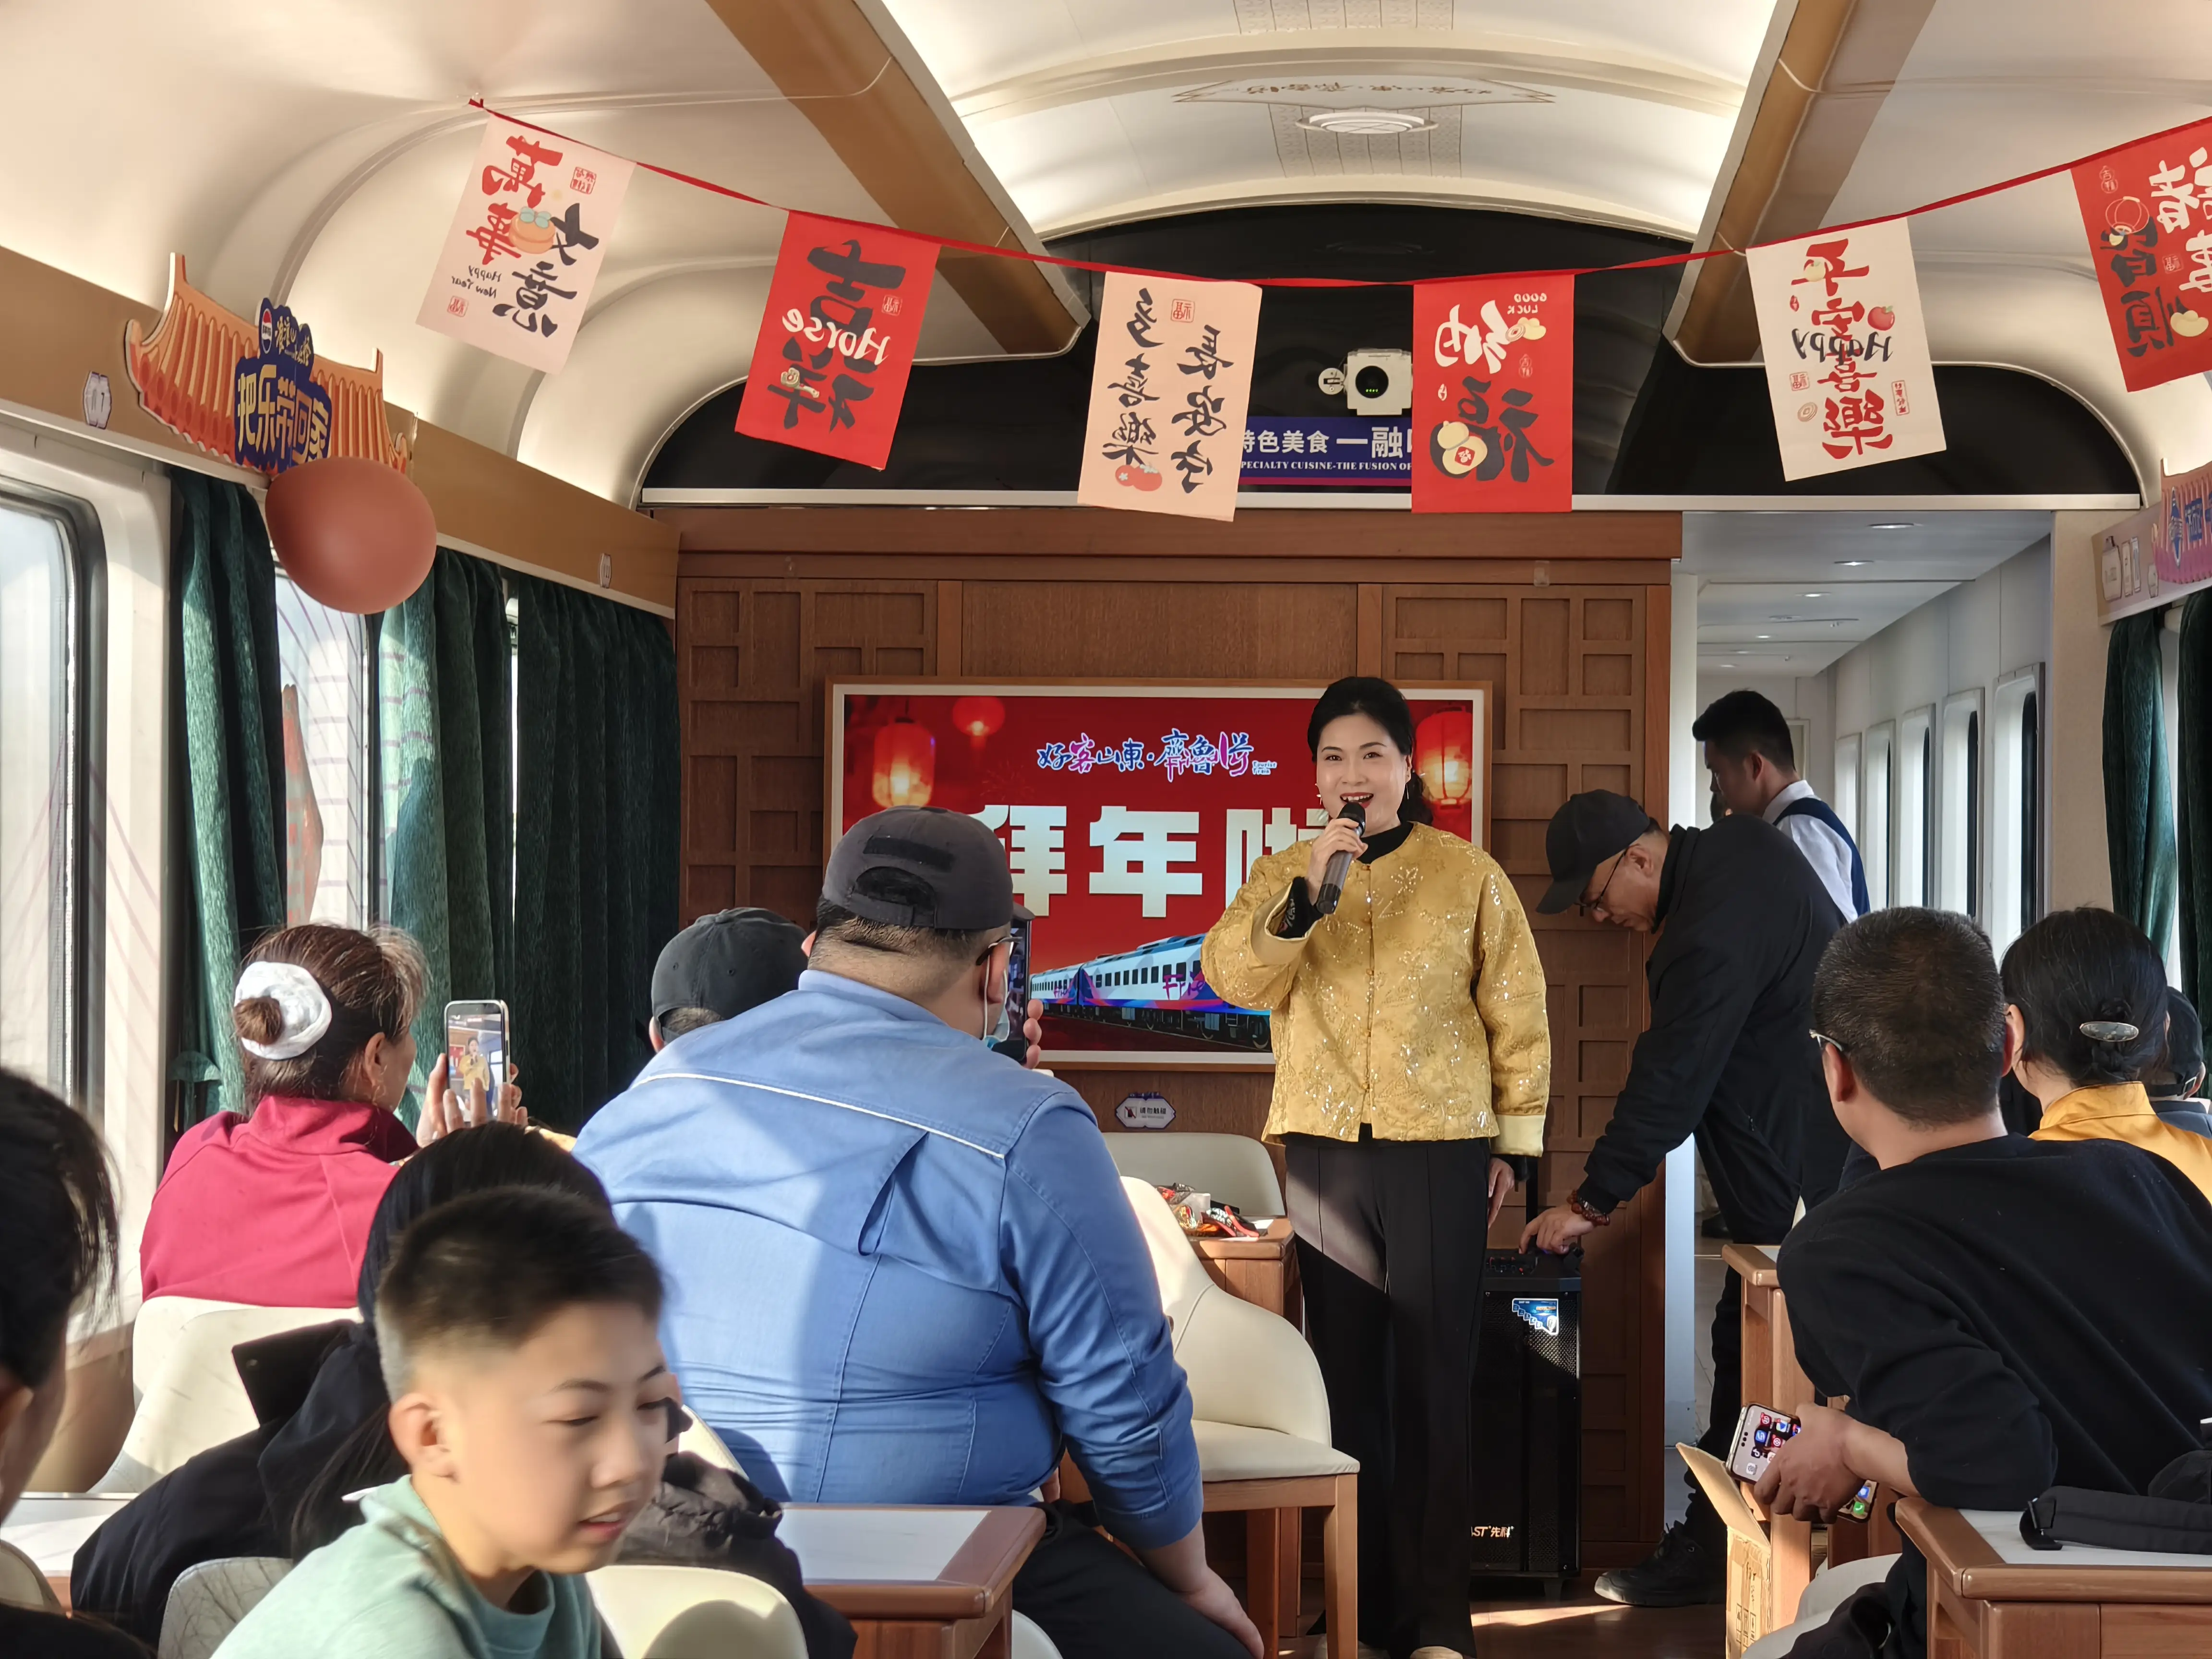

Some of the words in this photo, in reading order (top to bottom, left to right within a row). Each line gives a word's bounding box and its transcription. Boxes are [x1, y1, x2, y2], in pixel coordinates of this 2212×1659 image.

[238, 364, 329, 464] 把乐带回家
[1240, 461, 1289, 469] PECIALTY
[1359, 462, 1397, 470] FUSION
